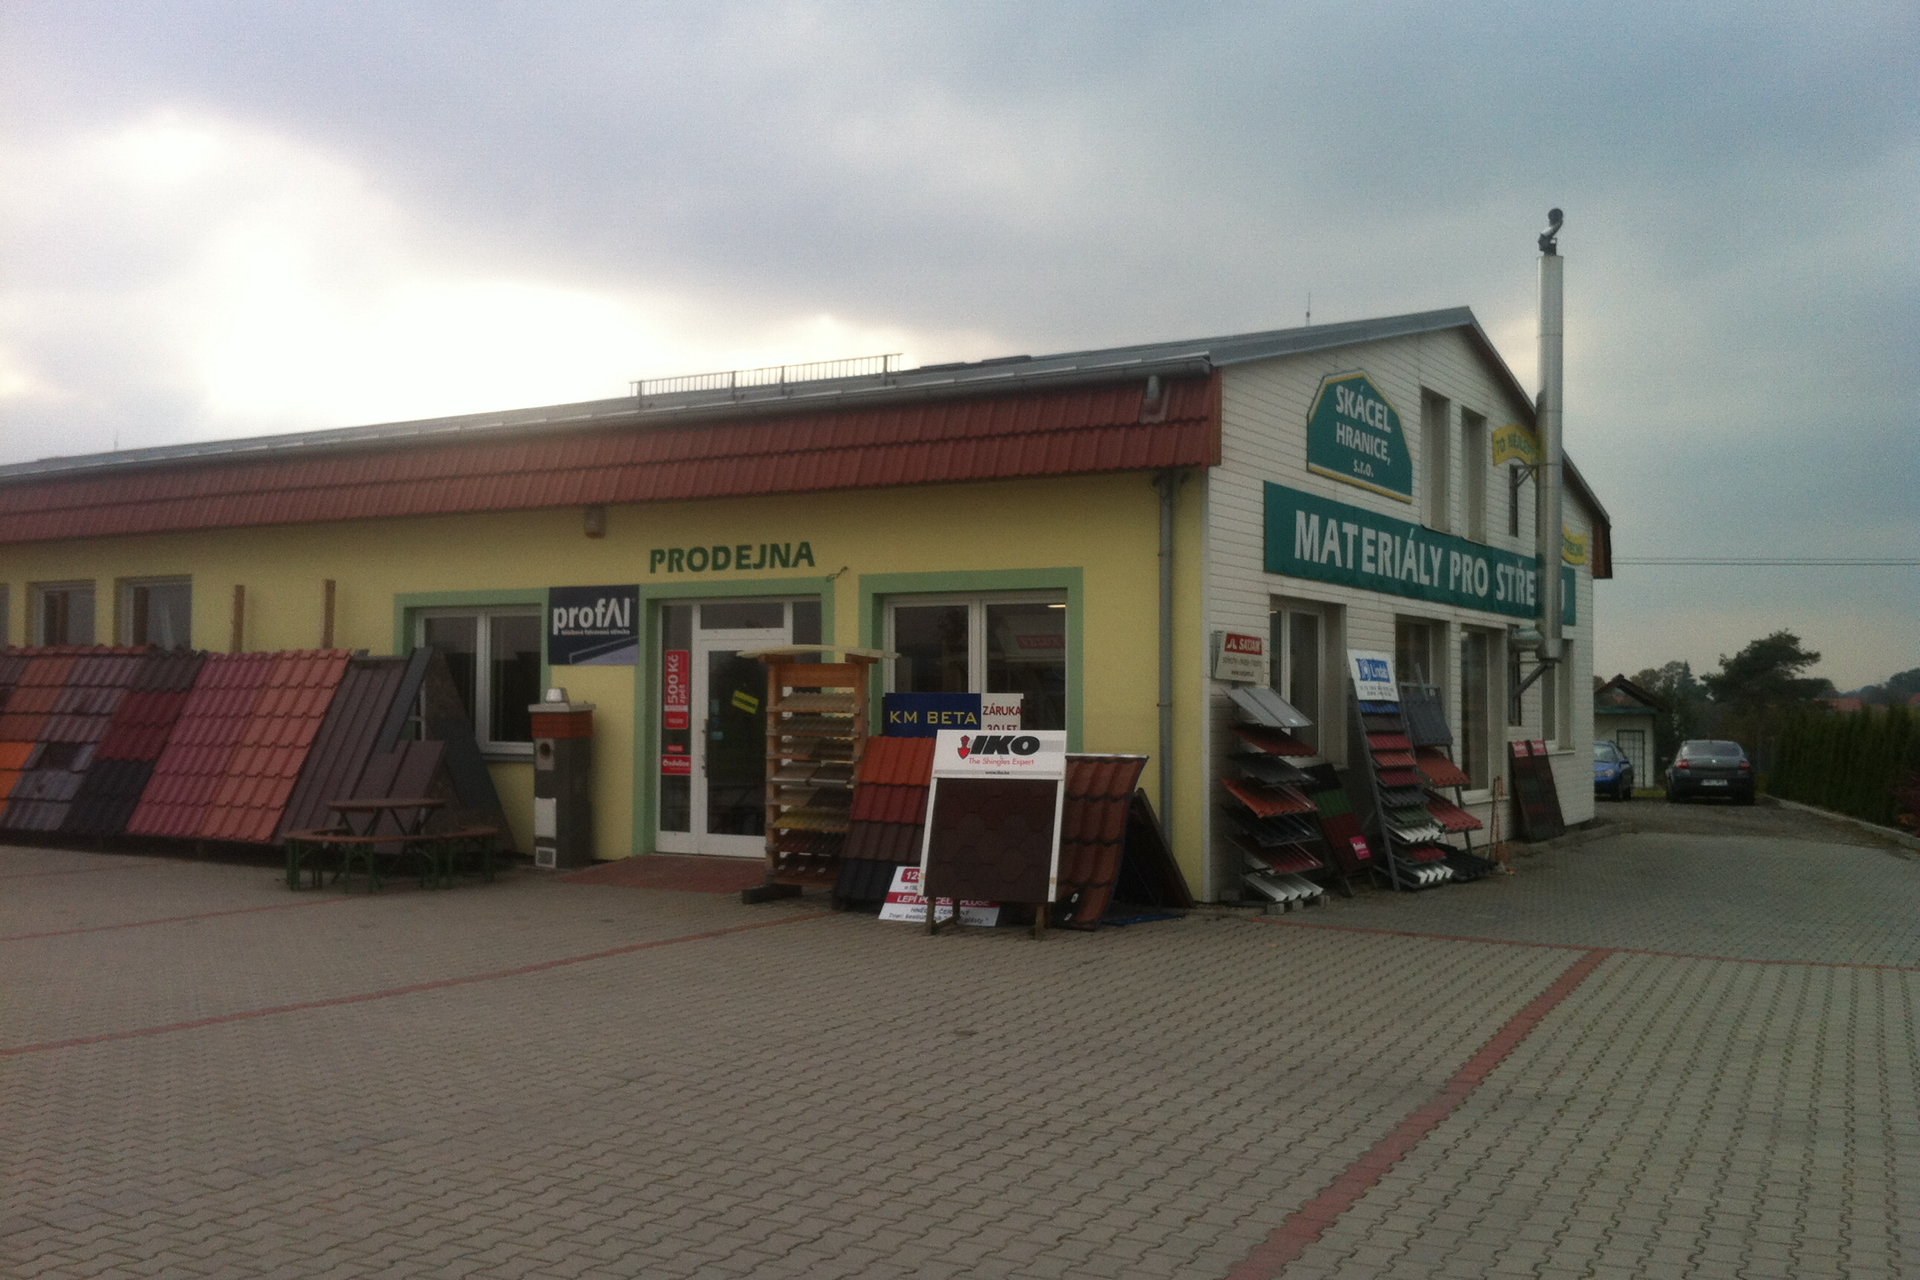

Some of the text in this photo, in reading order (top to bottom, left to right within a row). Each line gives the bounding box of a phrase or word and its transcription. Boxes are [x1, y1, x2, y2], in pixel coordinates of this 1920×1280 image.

[1336, 385, 1391, 433] SKÁCEL
[1336, 422, 1391, 466] HRANICE,
[1353, 459, 1375, 478] s.r.o.
[650, 541, 815, 574] PRODEJNA
[1294, 510, 1443, 588] MATERIÁLY
[1450, 551, 1489, 597] PRO
[667, 654, 679, 672] Kč
[667, 674, 679, 704] 500
[890, 711, 978, 725] KM BETA
[982, 703, 1022, 716] ZÁRUKA
[970, 735, 1041, 756] IKO
[969, 757, 1035, 767] The Shingles Expert
